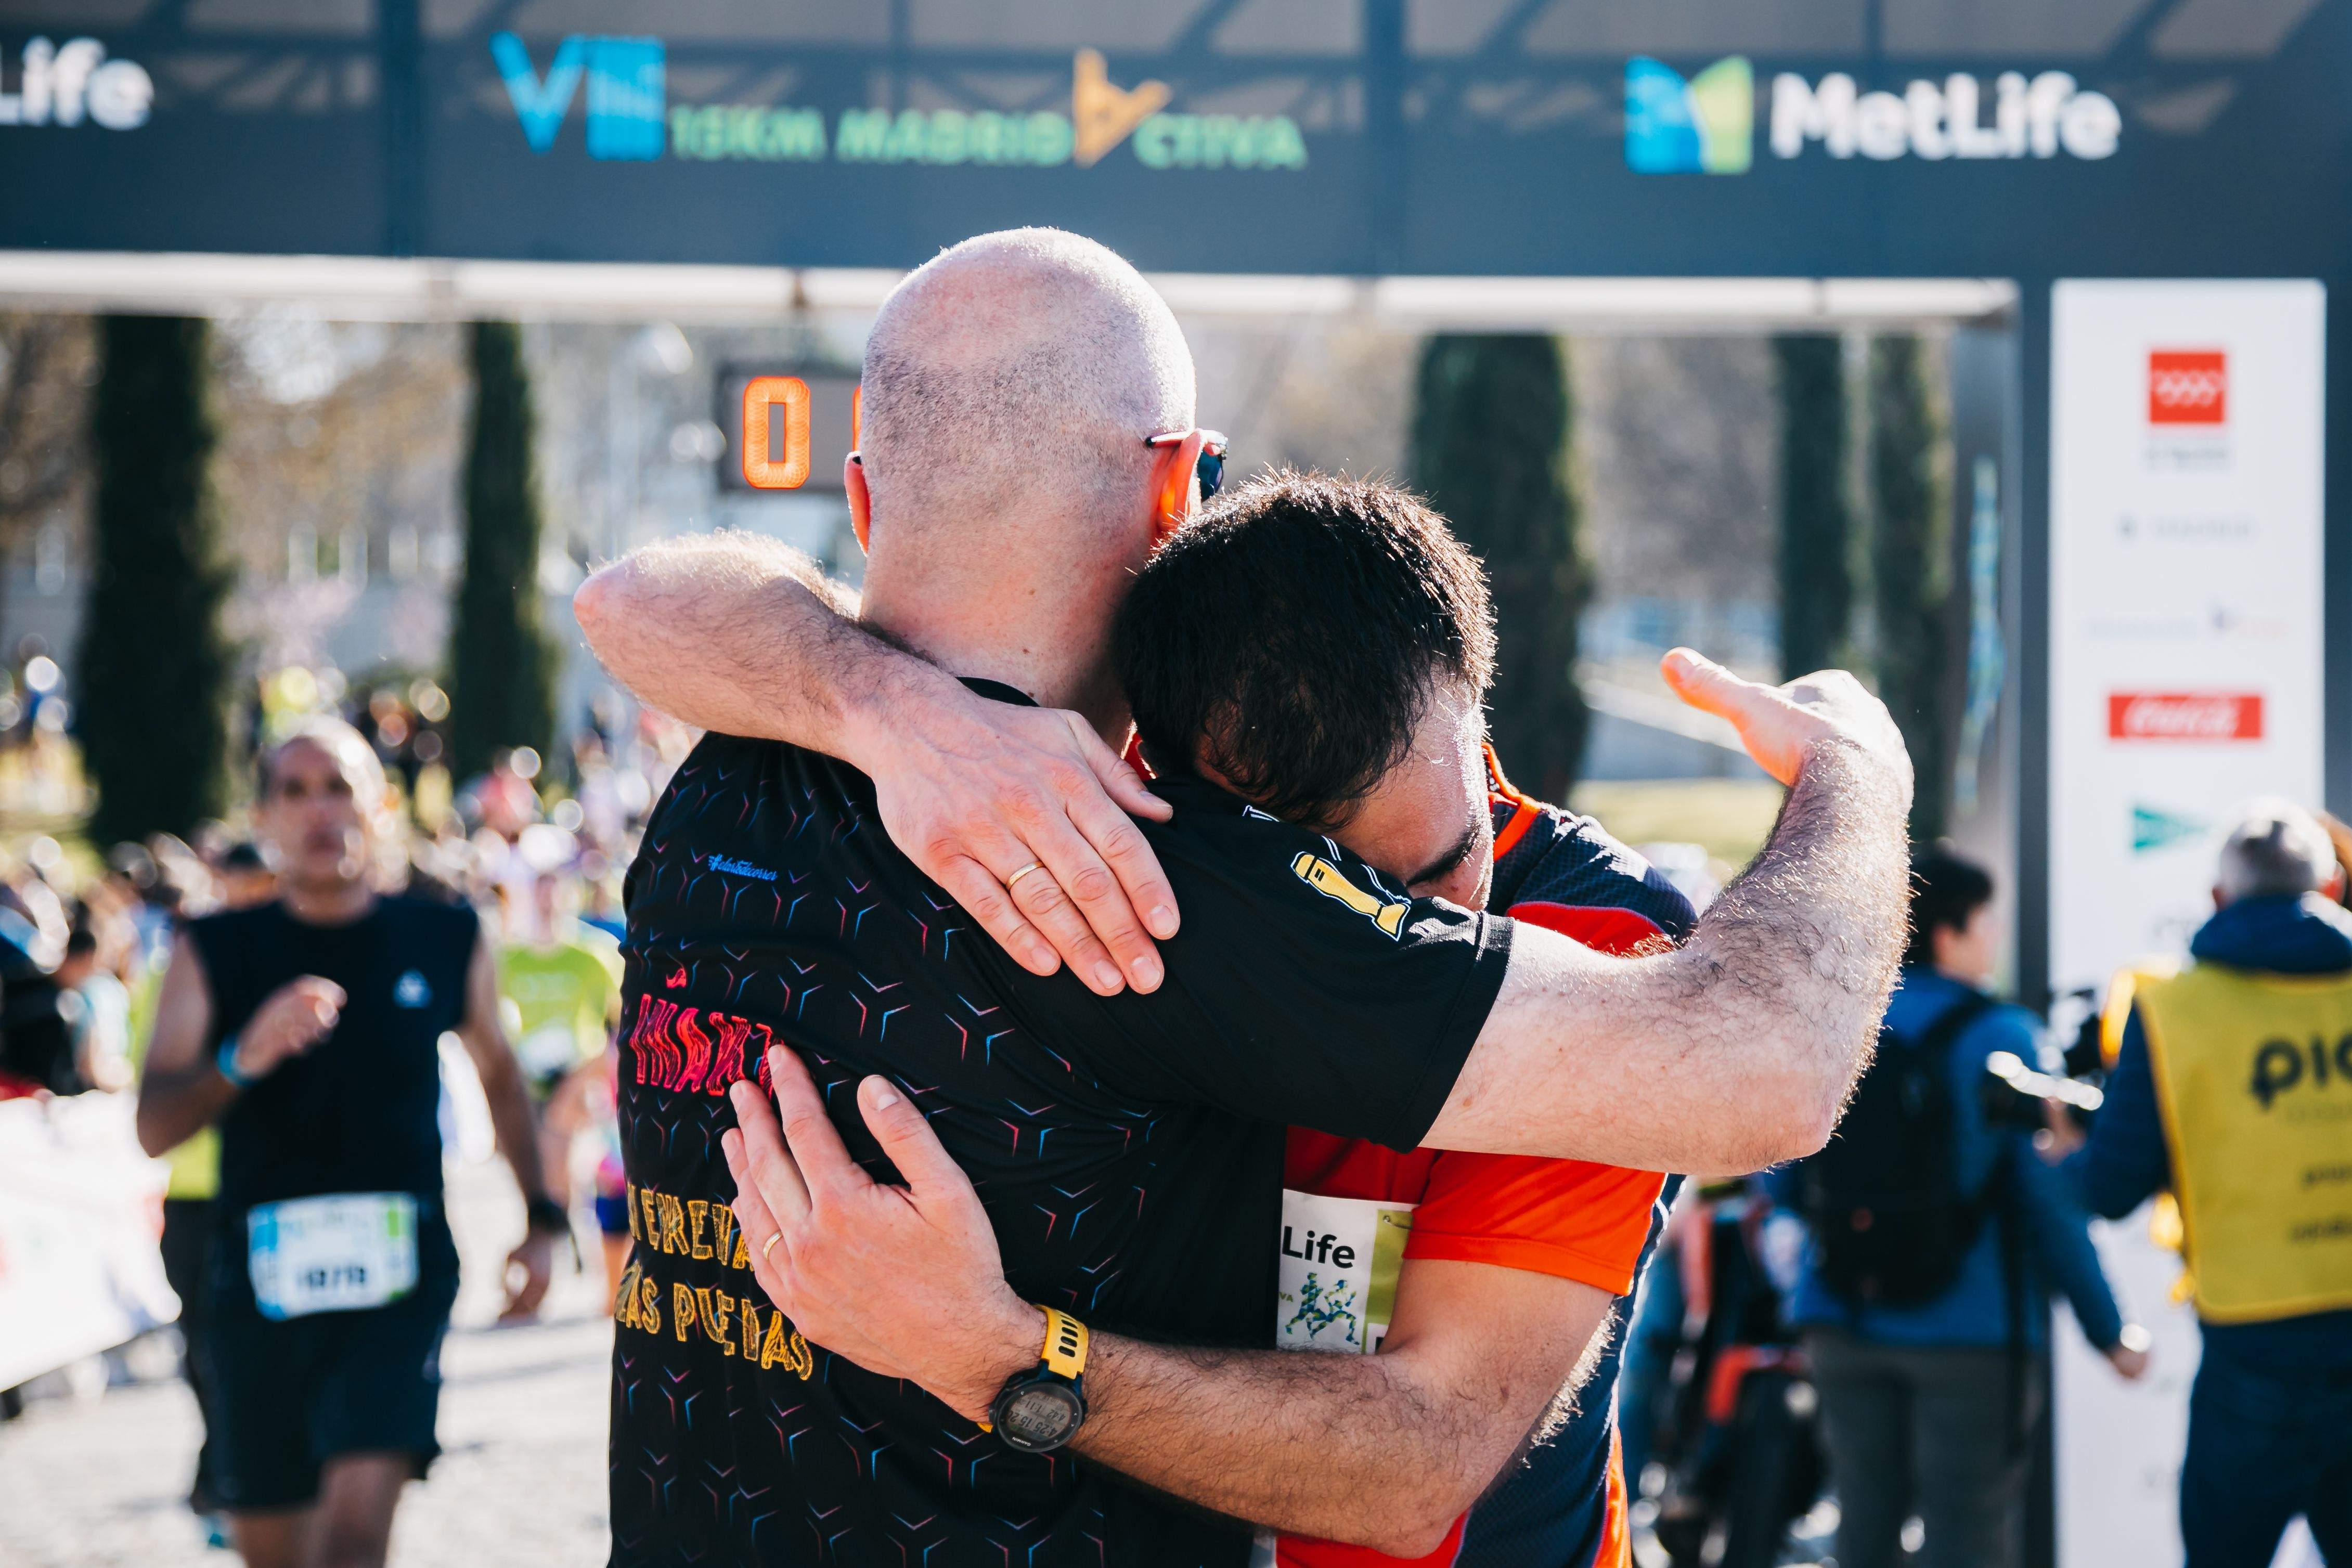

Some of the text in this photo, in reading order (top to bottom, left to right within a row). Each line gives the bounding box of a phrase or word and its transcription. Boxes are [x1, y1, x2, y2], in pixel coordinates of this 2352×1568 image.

[0, 34, 154, 131] ife
[1770, 70, 2122, 160] MetLife
[743, 375, 862, 490] 0
[1282, 1226, 1355, 1269] Life
